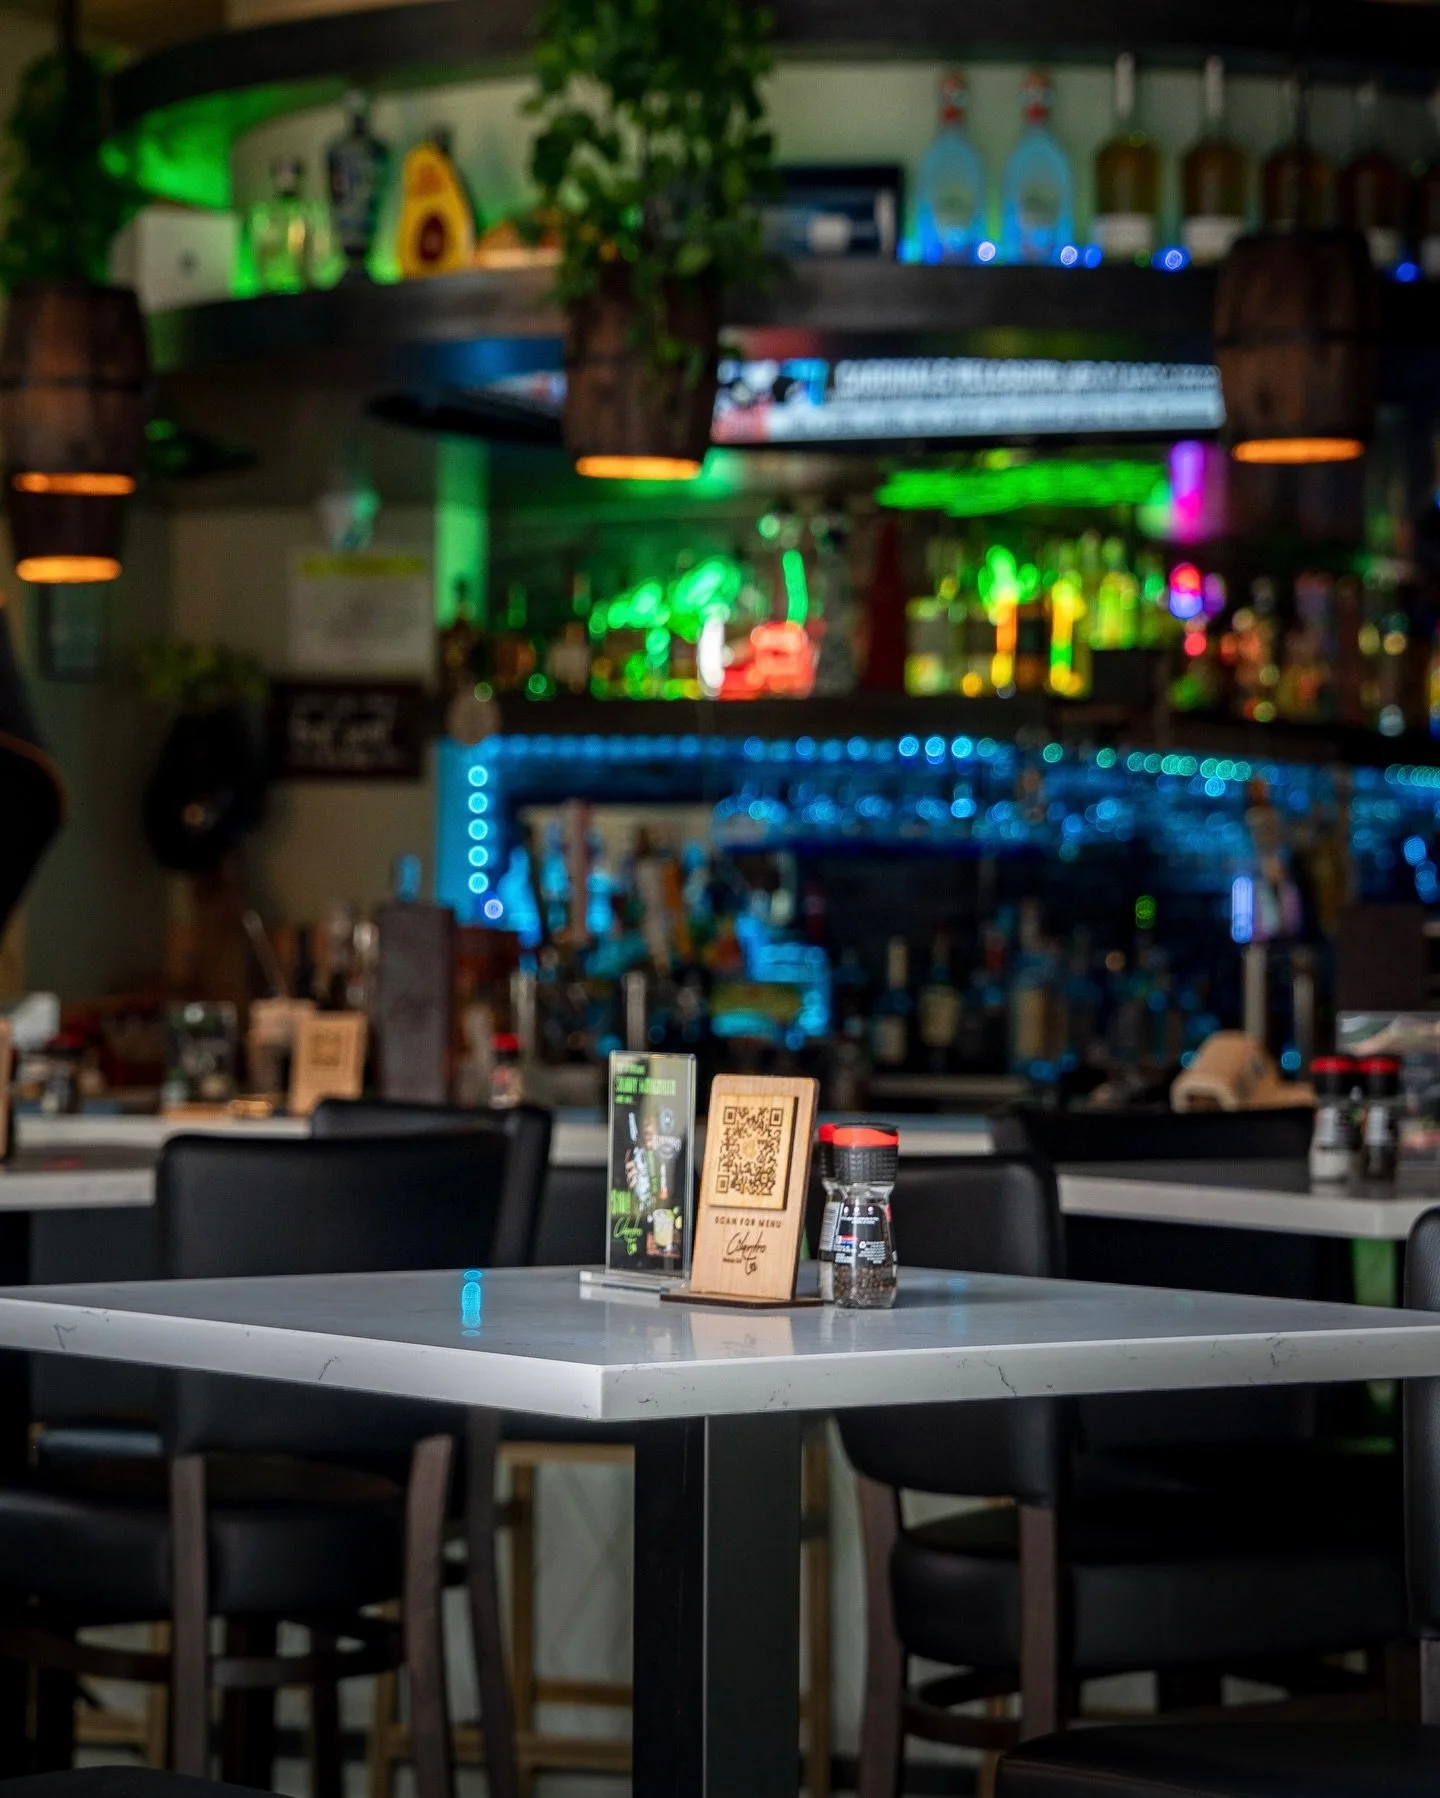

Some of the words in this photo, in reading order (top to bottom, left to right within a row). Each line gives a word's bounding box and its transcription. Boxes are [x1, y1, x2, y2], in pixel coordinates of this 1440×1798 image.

[715, 1216, 737, 1225] SCAN
[740, 1217, 756, 1227] FOR
[759, 1219, 782, 1229] MENU
[726, 1230, 768, 1260] Cilantro
